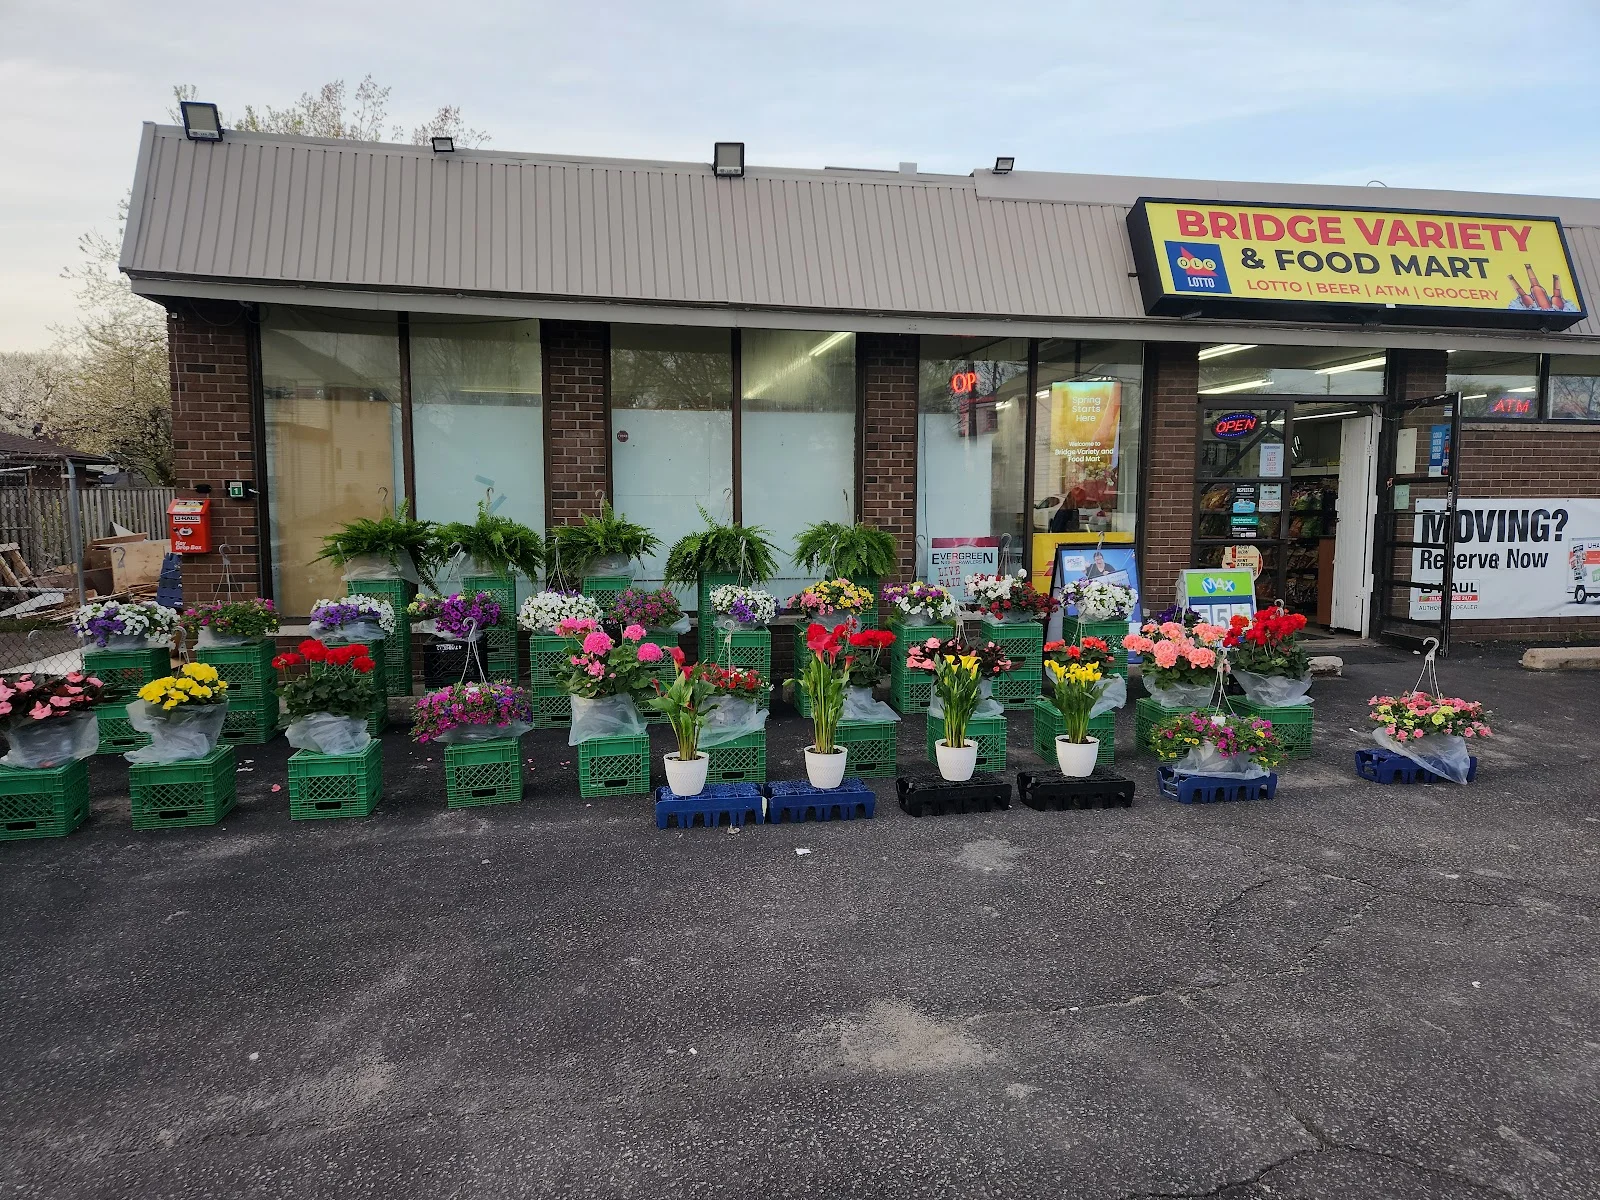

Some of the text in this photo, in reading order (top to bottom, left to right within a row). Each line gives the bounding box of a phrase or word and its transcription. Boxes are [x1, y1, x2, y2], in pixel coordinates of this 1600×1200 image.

[1176, 209, 1532, 252] BRIDGE VARIETY
[1178, 256, 1216, 271] OLG
[1241, 247, 1490, 280] & FOOD MART
[1187, 276, 1215, 289] LOTTO
[1246, 279, 1303, 293] LOTTO
[1317, 282, 1361, 296] BEER
[1375, 285, 1411, 297] ATM
[1422, 287, 1499, 301] GROCERY
[1071, 396, 1101, 406] Spring
[1493, 398, 1530, 412] ATM
[1071, 405, 1101, 413] Starts
[1075, 414, 1097, 422] Here
[1216, 417, 1257, 432] OPEN
[1054, 448, 1076, 456] Bridge
[1077, 448, 1101, 456] Variety
[1421, 508, 1569, 544] MOVING?
[931, 551, 994, 565] EVERGREEN
[1506, 548, 1549, 569] Now
[938, 565, 961, 577] LIVE
[938, 577, 961, 588] BAIT
[1201, 577, 1236, 594] MAX
